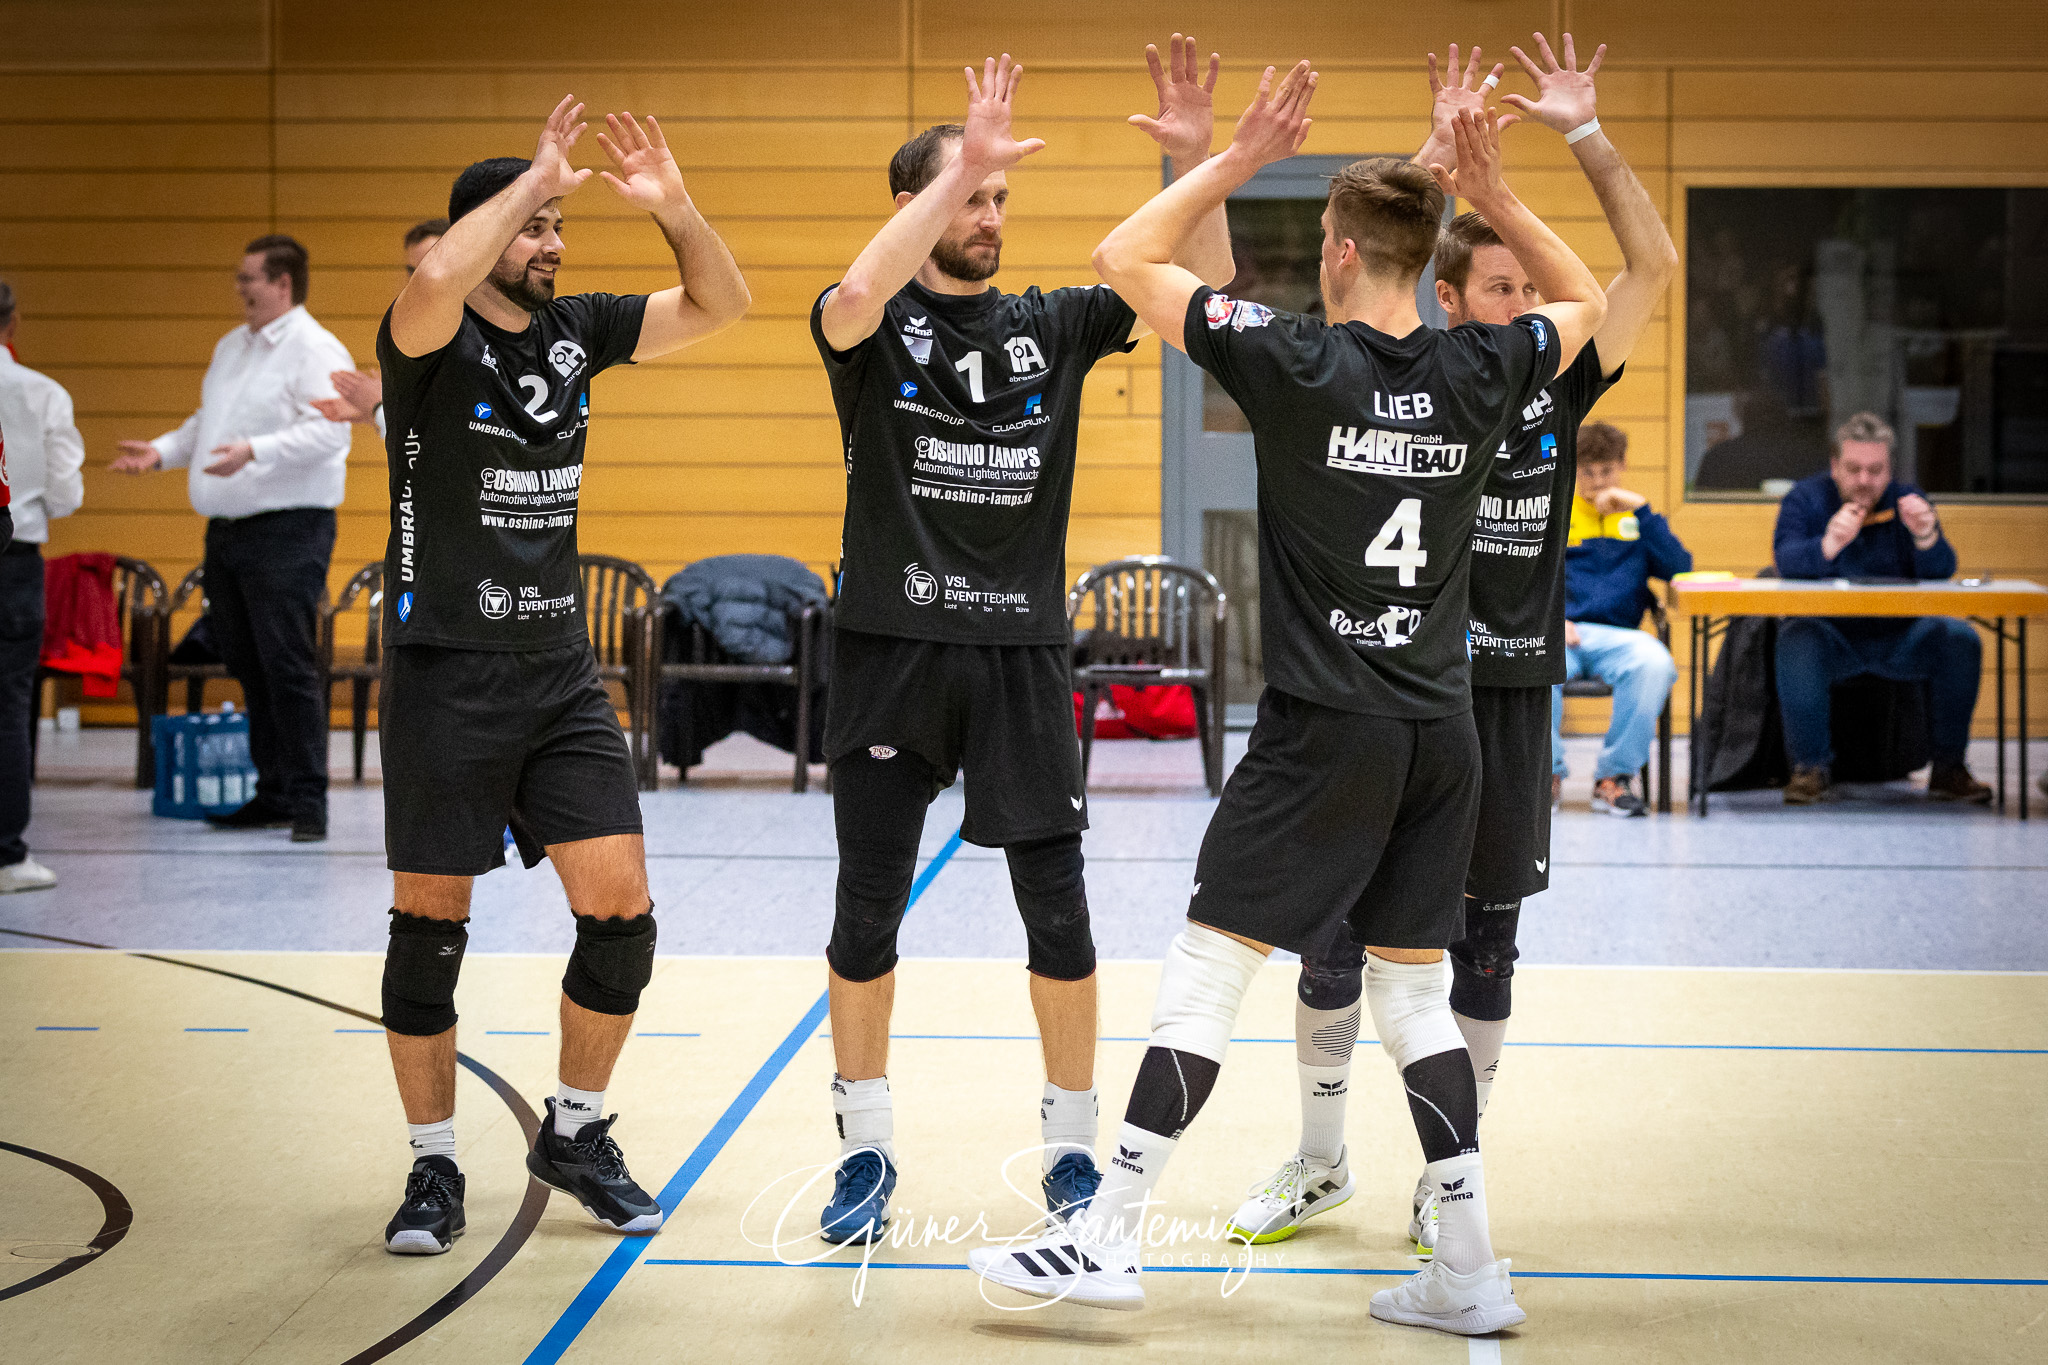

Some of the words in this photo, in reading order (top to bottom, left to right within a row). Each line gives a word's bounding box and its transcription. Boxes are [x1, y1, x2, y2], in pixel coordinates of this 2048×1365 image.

[903, 324, 933, 336] erima
[955, 351, 986, 403] 1
[518, 374, 558, 424] 2
[1374, 390, 1434, 420] LIEB
[893, 399, 965, 426] UMBRAGROUP
[992, 415, 1050, 433] CUADRUM
[1328, 425, 1413, 465] HART
[1413, 434, 1443, 444] GmbH
[927, 437, 985, 466] OSHINO
[989, 444, 1041, 469] LAMPS
[1411, 448, 1461, 473] BAU
[913, 459, 965, 477] Automotive
[967, 467, 1001, 481] Lighted
[1002, 470, 1039, 481] Products
[479, 490, 527, 505] Automotive
[528, 493, 557, 506] Lighted
[911, 483, 1033, 507] www.oshino-lamps.de
[481, 514, 574, 529] www.oshino-lamps
[1484, 520, 1519, 532] Lighted
[1365, 498, 1427, 587] 4
[944, 574, 971, 588] VSL
[519, 586, 541, 598] VSL
[1329, 608, 1377, 637] Pose
[1469, 620, 1492, 634] VSL
[1313, 1087, 1347, 1097] erima
[1111, 1156, 1144, 1175] erima
[1440, 1190, 1474, 1203] erima
